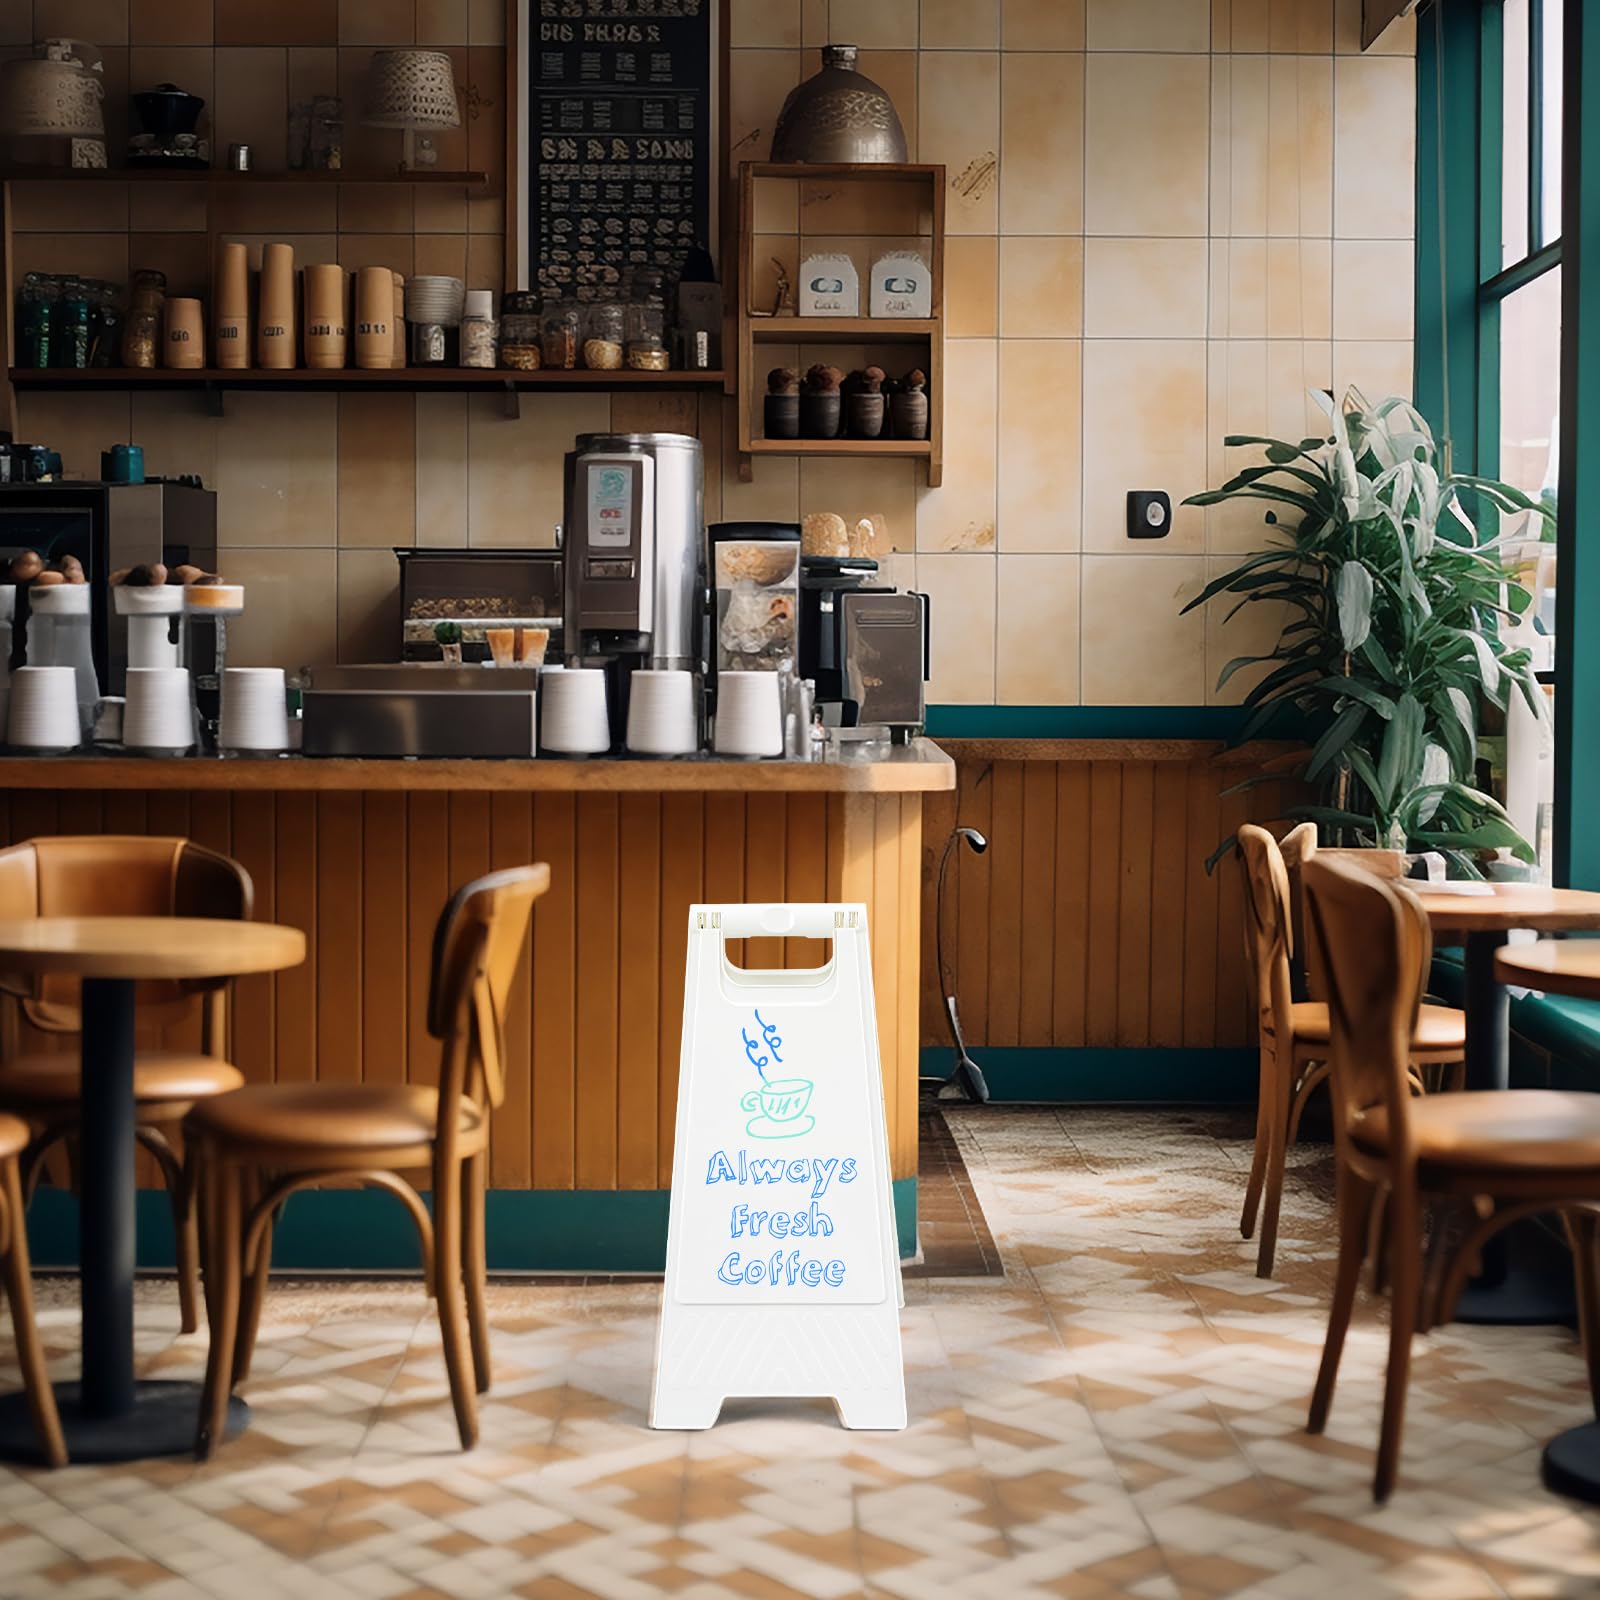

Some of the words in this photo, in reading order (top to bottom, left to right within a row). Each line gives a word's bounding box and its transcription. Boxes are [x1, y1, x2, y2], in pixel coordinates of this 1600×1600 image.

[706, 1150, 857, 1199] Always
[731, 1201, 834, 1239] Fresh
[718, 1250, 846, 1287] Coffee
